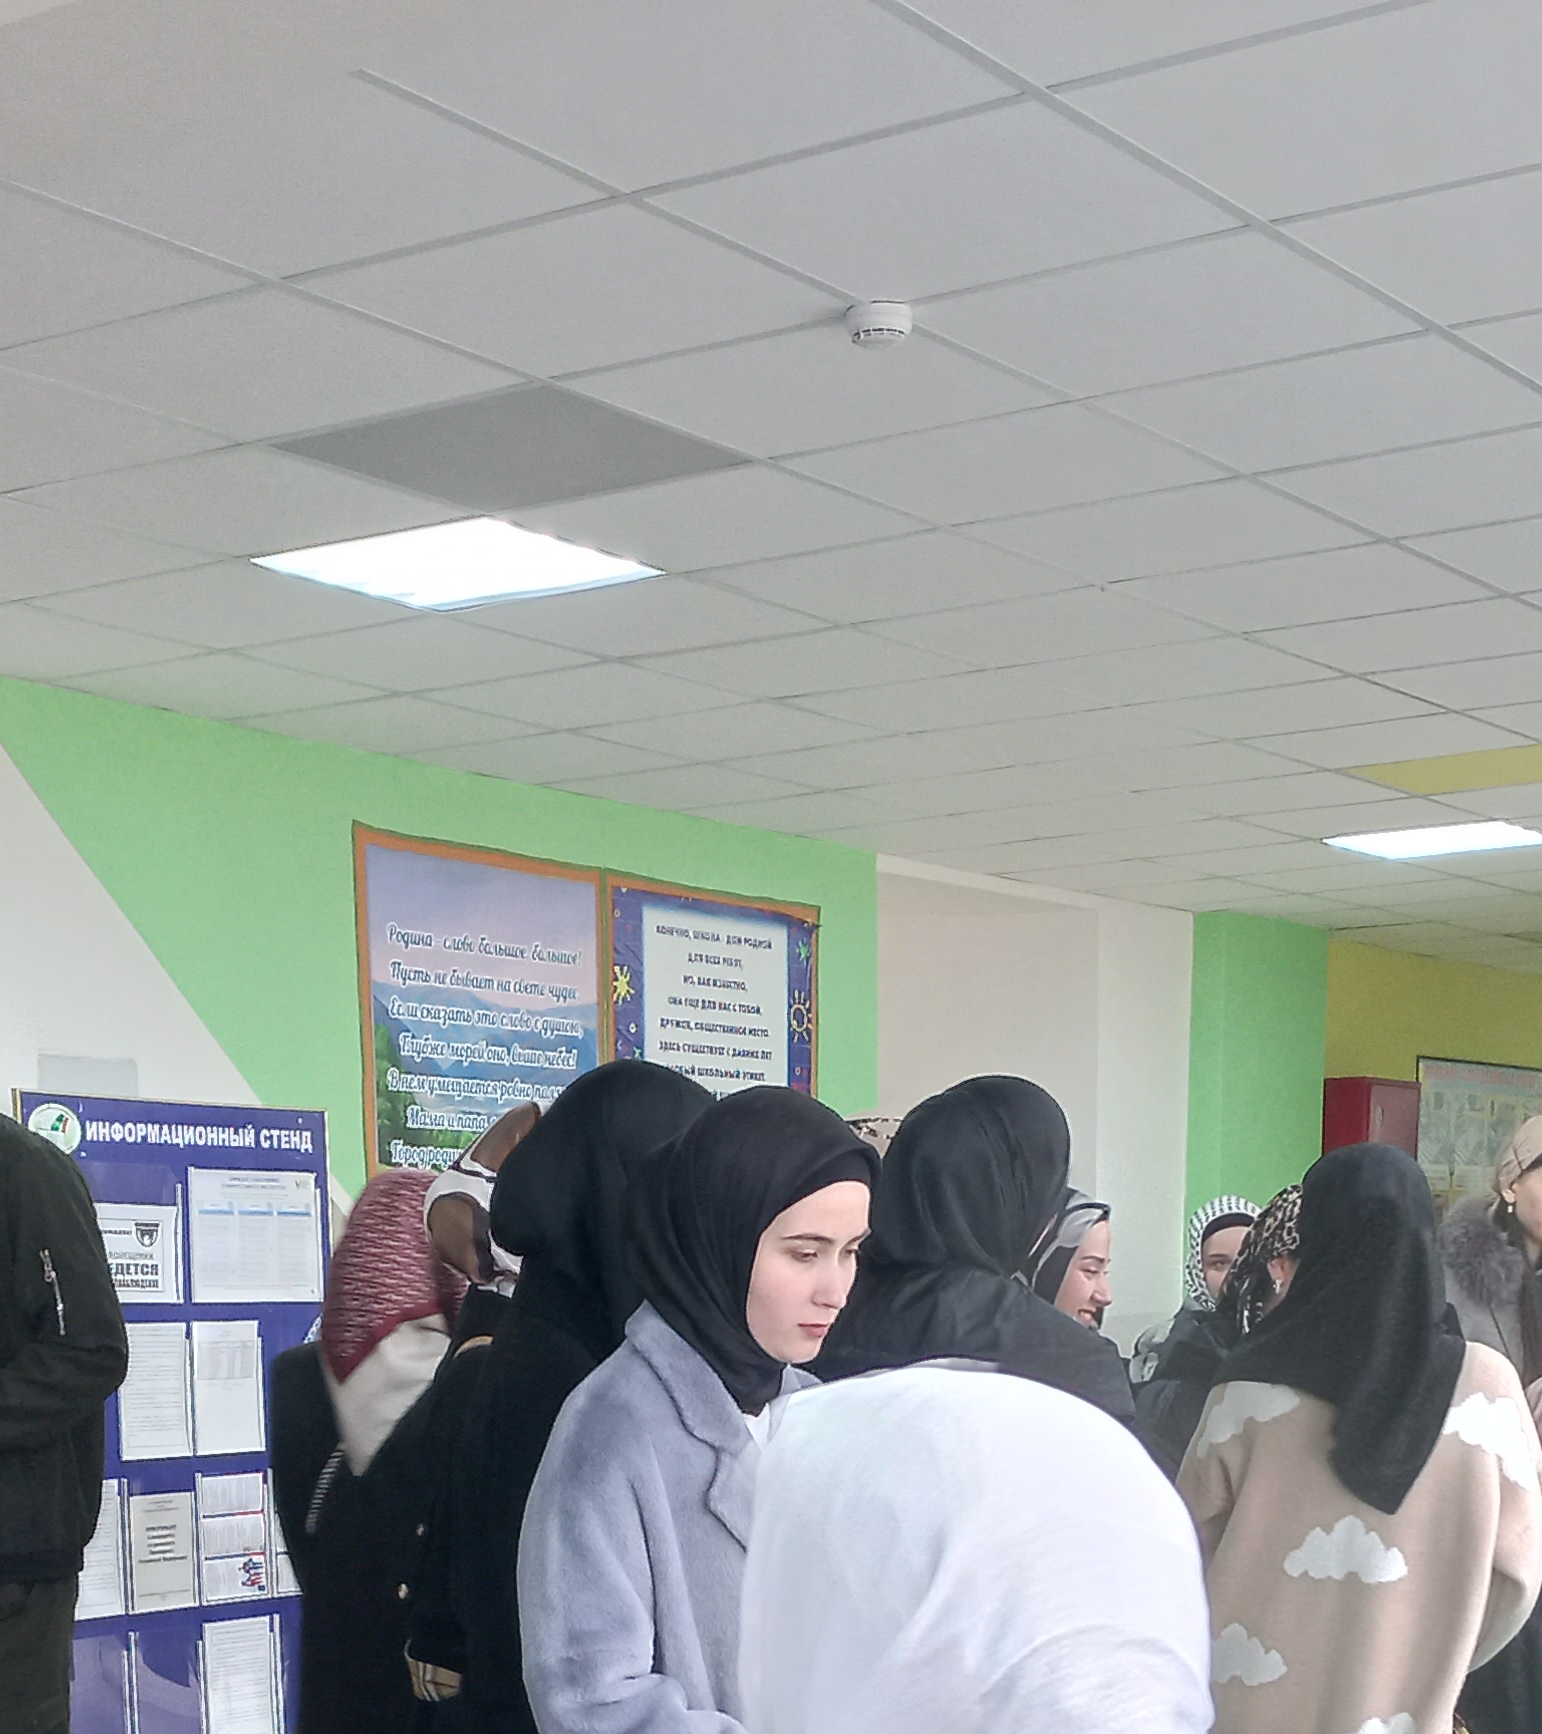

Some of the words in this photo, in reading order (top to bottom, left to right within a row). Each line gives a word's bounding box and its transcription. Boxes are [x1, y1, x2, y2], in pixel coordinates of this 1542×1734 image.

[387, 923, 432, 948] Родина
[443, 934, 475, 953] слово
[479, 937, 527, 958] большое
[693, 930, 720, 941] ШКОЛА
[726, 935, 742, 945] ДОМ
[744, 937, 772, 949] РОДНОЙ
[390, 961, 431, 985] Пусть
[434, 972, 447, 985] не
[450, 969, 494, 988] бывает
[497, 980, 511, 992] на
[513, 980, 546, 996] свете
[390, 997, 419, 1015] Если
[420, 1004, 472, 1027] сказать
[475, 1010, 497, 1025] это
[500, 1012, 532, 1029] слово
[400, 1033, 447, 1061] Глубже
[450, 1041, 487, 1065] морей
[487, 1048, 509, 1065] оно,
[659, 1040, 680, 1052] ЗДЕСЬ
[682, 1043, 725, 1056] СУЩЕСТВУЕТ
[388, 1069, 400, 1090] В
[428, 1078, 498, 1098] умещается
[499, 1079, 532, 1103] ровно
[698, 1067, 740, 1079] ШКОЛЬНЫЙ
[408, 1107, 445, 1127] Мама
[448, 1114, 456, 1128] и
[457, 1115, 486, 1130] папа
[85, 1120, 255, 1148] ИНФОРМАЦИОННЫЙ
[260, 1128, 313, 1153] СТЕНД
[391, 1141, 427, 1166] Город
